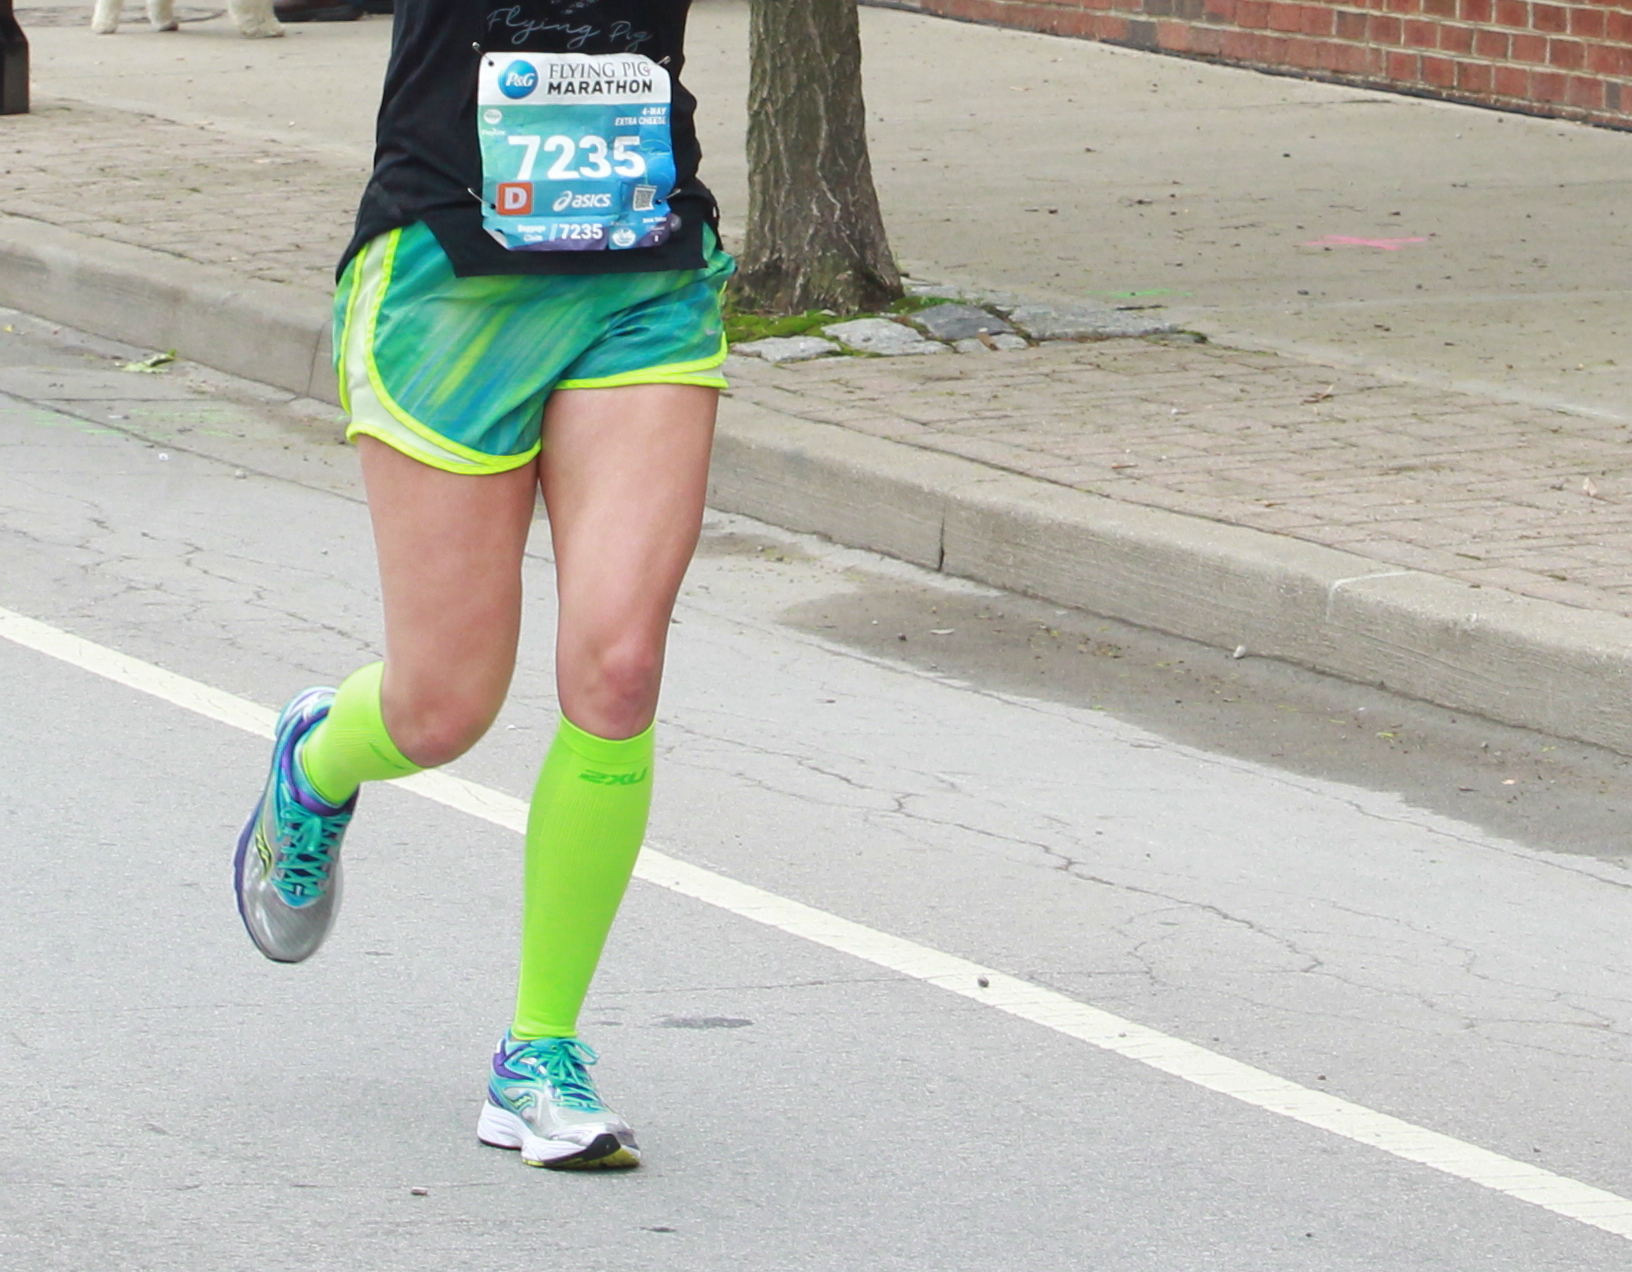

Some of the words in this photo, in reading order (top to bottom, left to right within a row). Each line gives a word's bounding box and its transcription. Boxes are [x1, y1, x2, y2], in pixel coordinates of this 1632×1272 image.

[487, 5, 601, 50] Flying
[609, 20, 653, 52] Pig
[505, 73, 535, 88] P&G
[549, 62, 615, 79] FLYING
[623, 61, 652, 77] PIG
[547, 79, 653, 96] MARATHON
[507, 134, 646, 180] 7235
[504, 187, 528, 210] D
[558, 223, 603, 240] 7235
